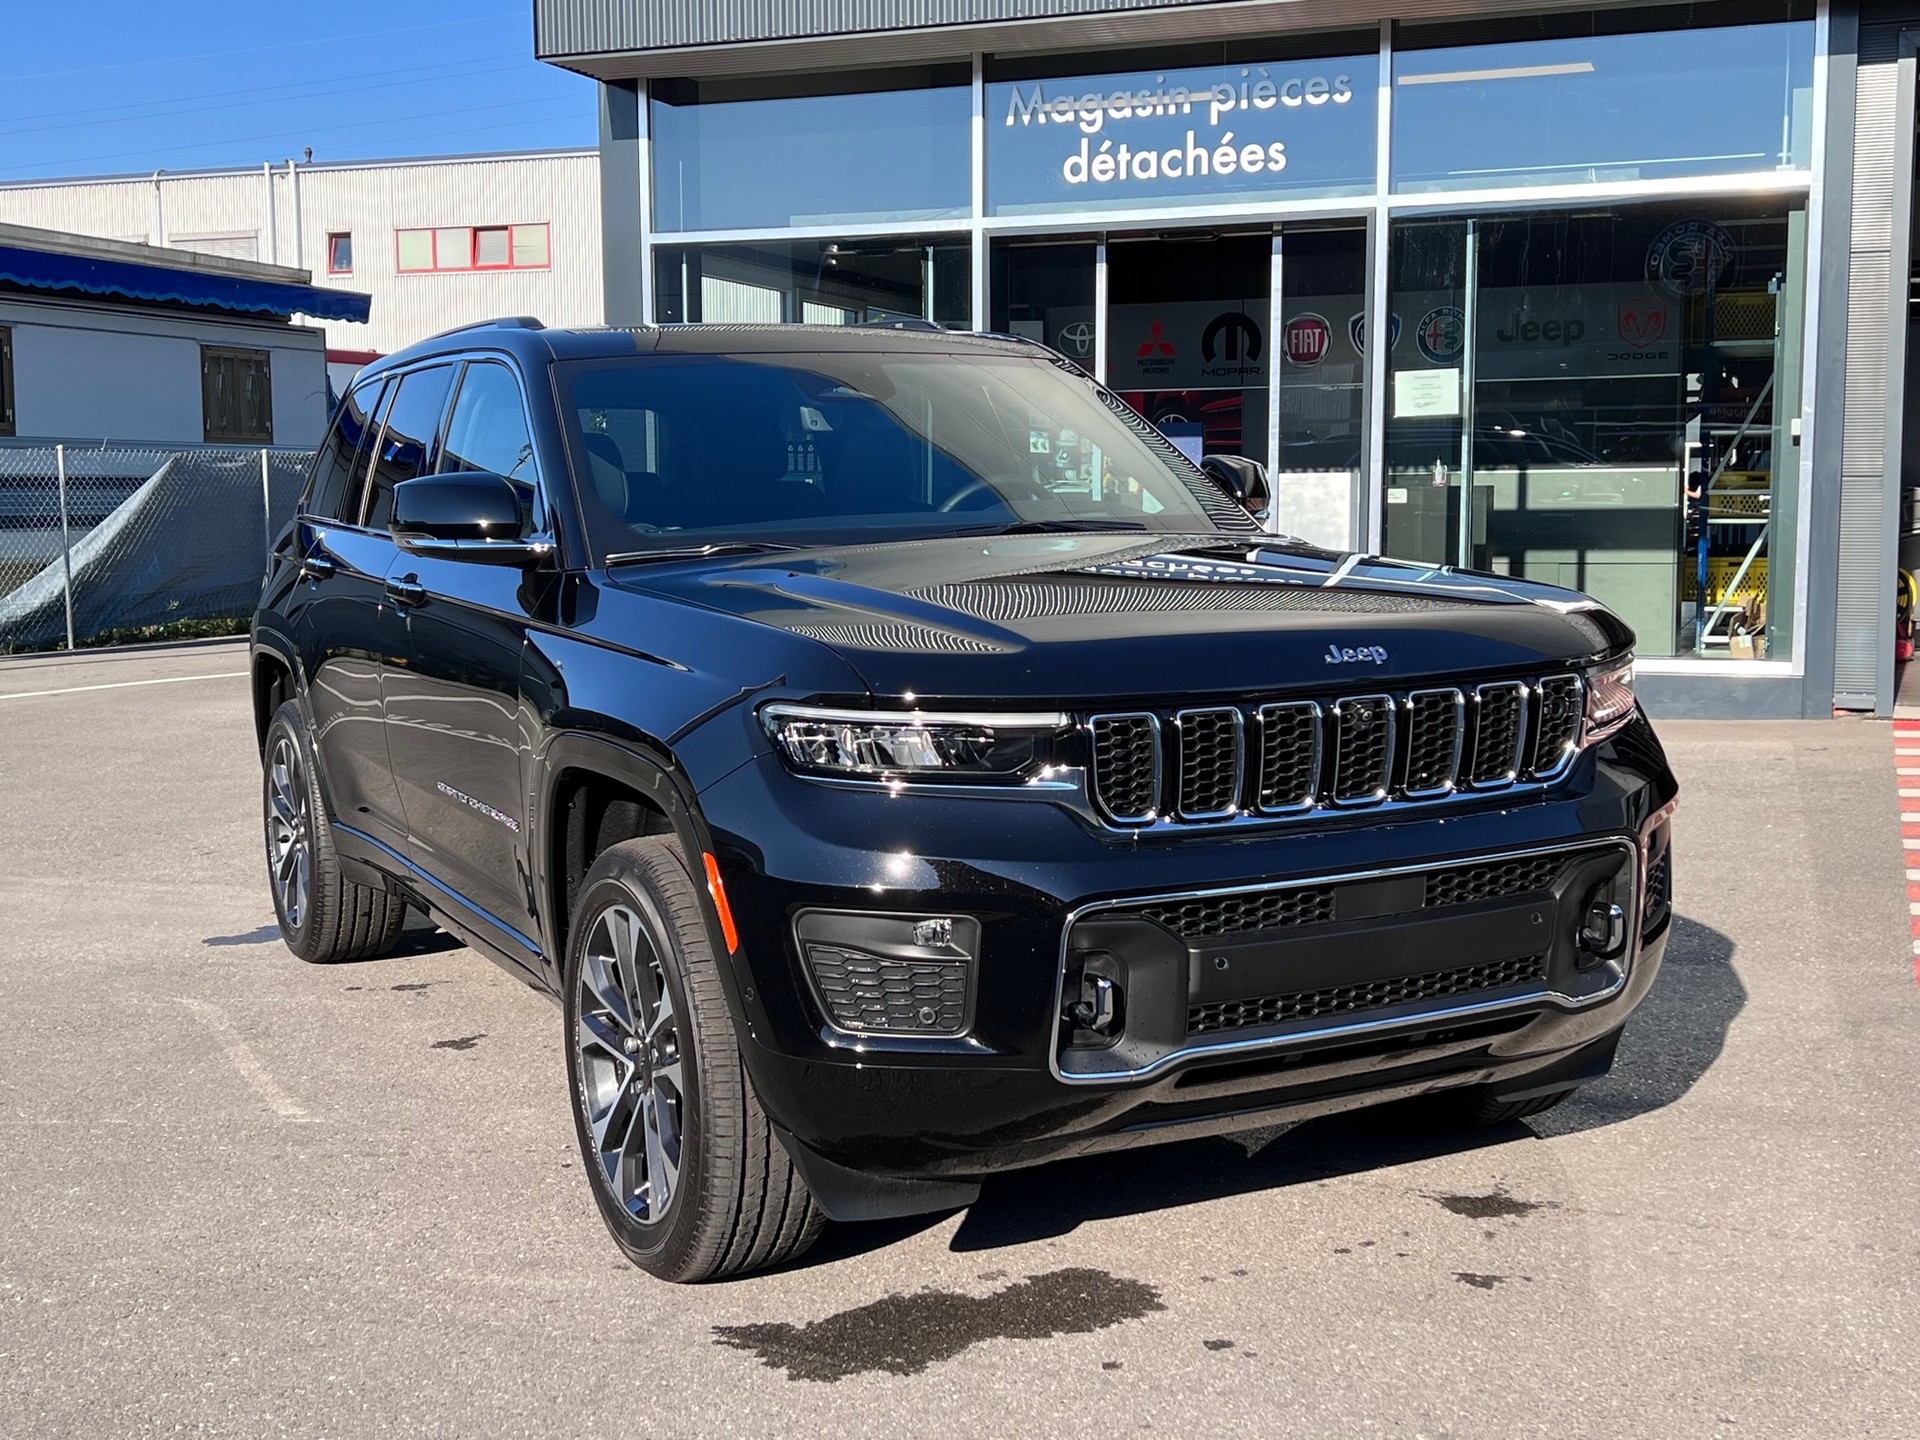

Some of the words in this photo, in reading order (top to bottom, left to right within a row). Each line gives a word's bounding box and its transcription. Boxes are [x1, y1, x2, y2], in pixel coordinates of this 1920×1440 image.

[1005, 75, 1192, 134] Magasin
[1209, 67, 1353, 125] pièces
[1062, 130, 1288, 184] détachées
[1419, 312, 1438, 336] ALFA
[1496, 313, 1585, 346] Jeep
[1291, 328, 1323, 354] FIAT
[1137, 358, 1176, 367] MITSUBISHI
[1607, 351, 1669, 361] DODGE
[1142, 366, 1170, 375] MOTORS
[1324, 644, 1389, 665] Jeep
